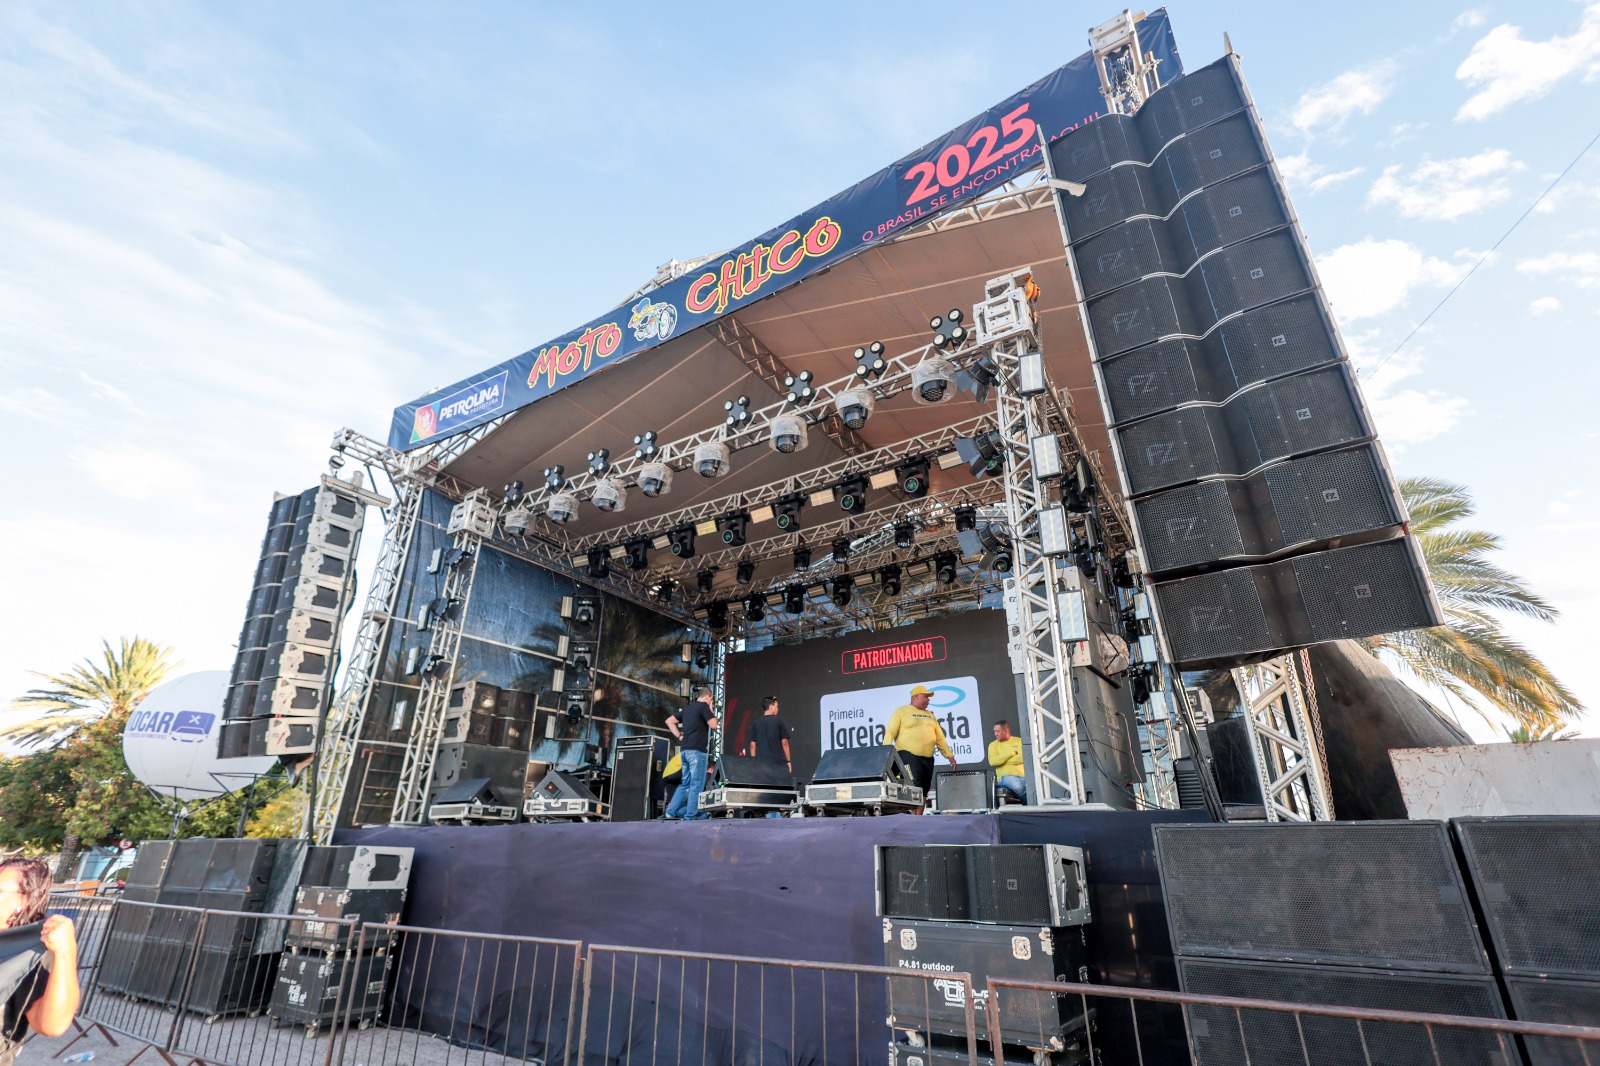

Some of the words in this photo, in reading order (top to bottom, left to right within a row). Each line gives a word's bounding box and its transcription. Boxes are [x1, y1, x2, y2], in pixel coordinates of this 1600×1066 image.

[905, 102, 1036, 206] 2025
[862, 230, 874, 242] O
[877, 207, 926, 235] BRASIL
[931, 194, 948, 208] SE
[953, 144, 1042, 198] ENCONTRA
[528, 321, 622, 388] MOTO
[685, 216, 841, 314] CHICO
[439, 384, 499, 421] PETROLINA
[854, 642, 933, 669] PATROCINADOR
[829, 708, 864, 720] Primeira
[899, 959, 920, 969] P4.81
[922, 962, 954, 972] outdoor
